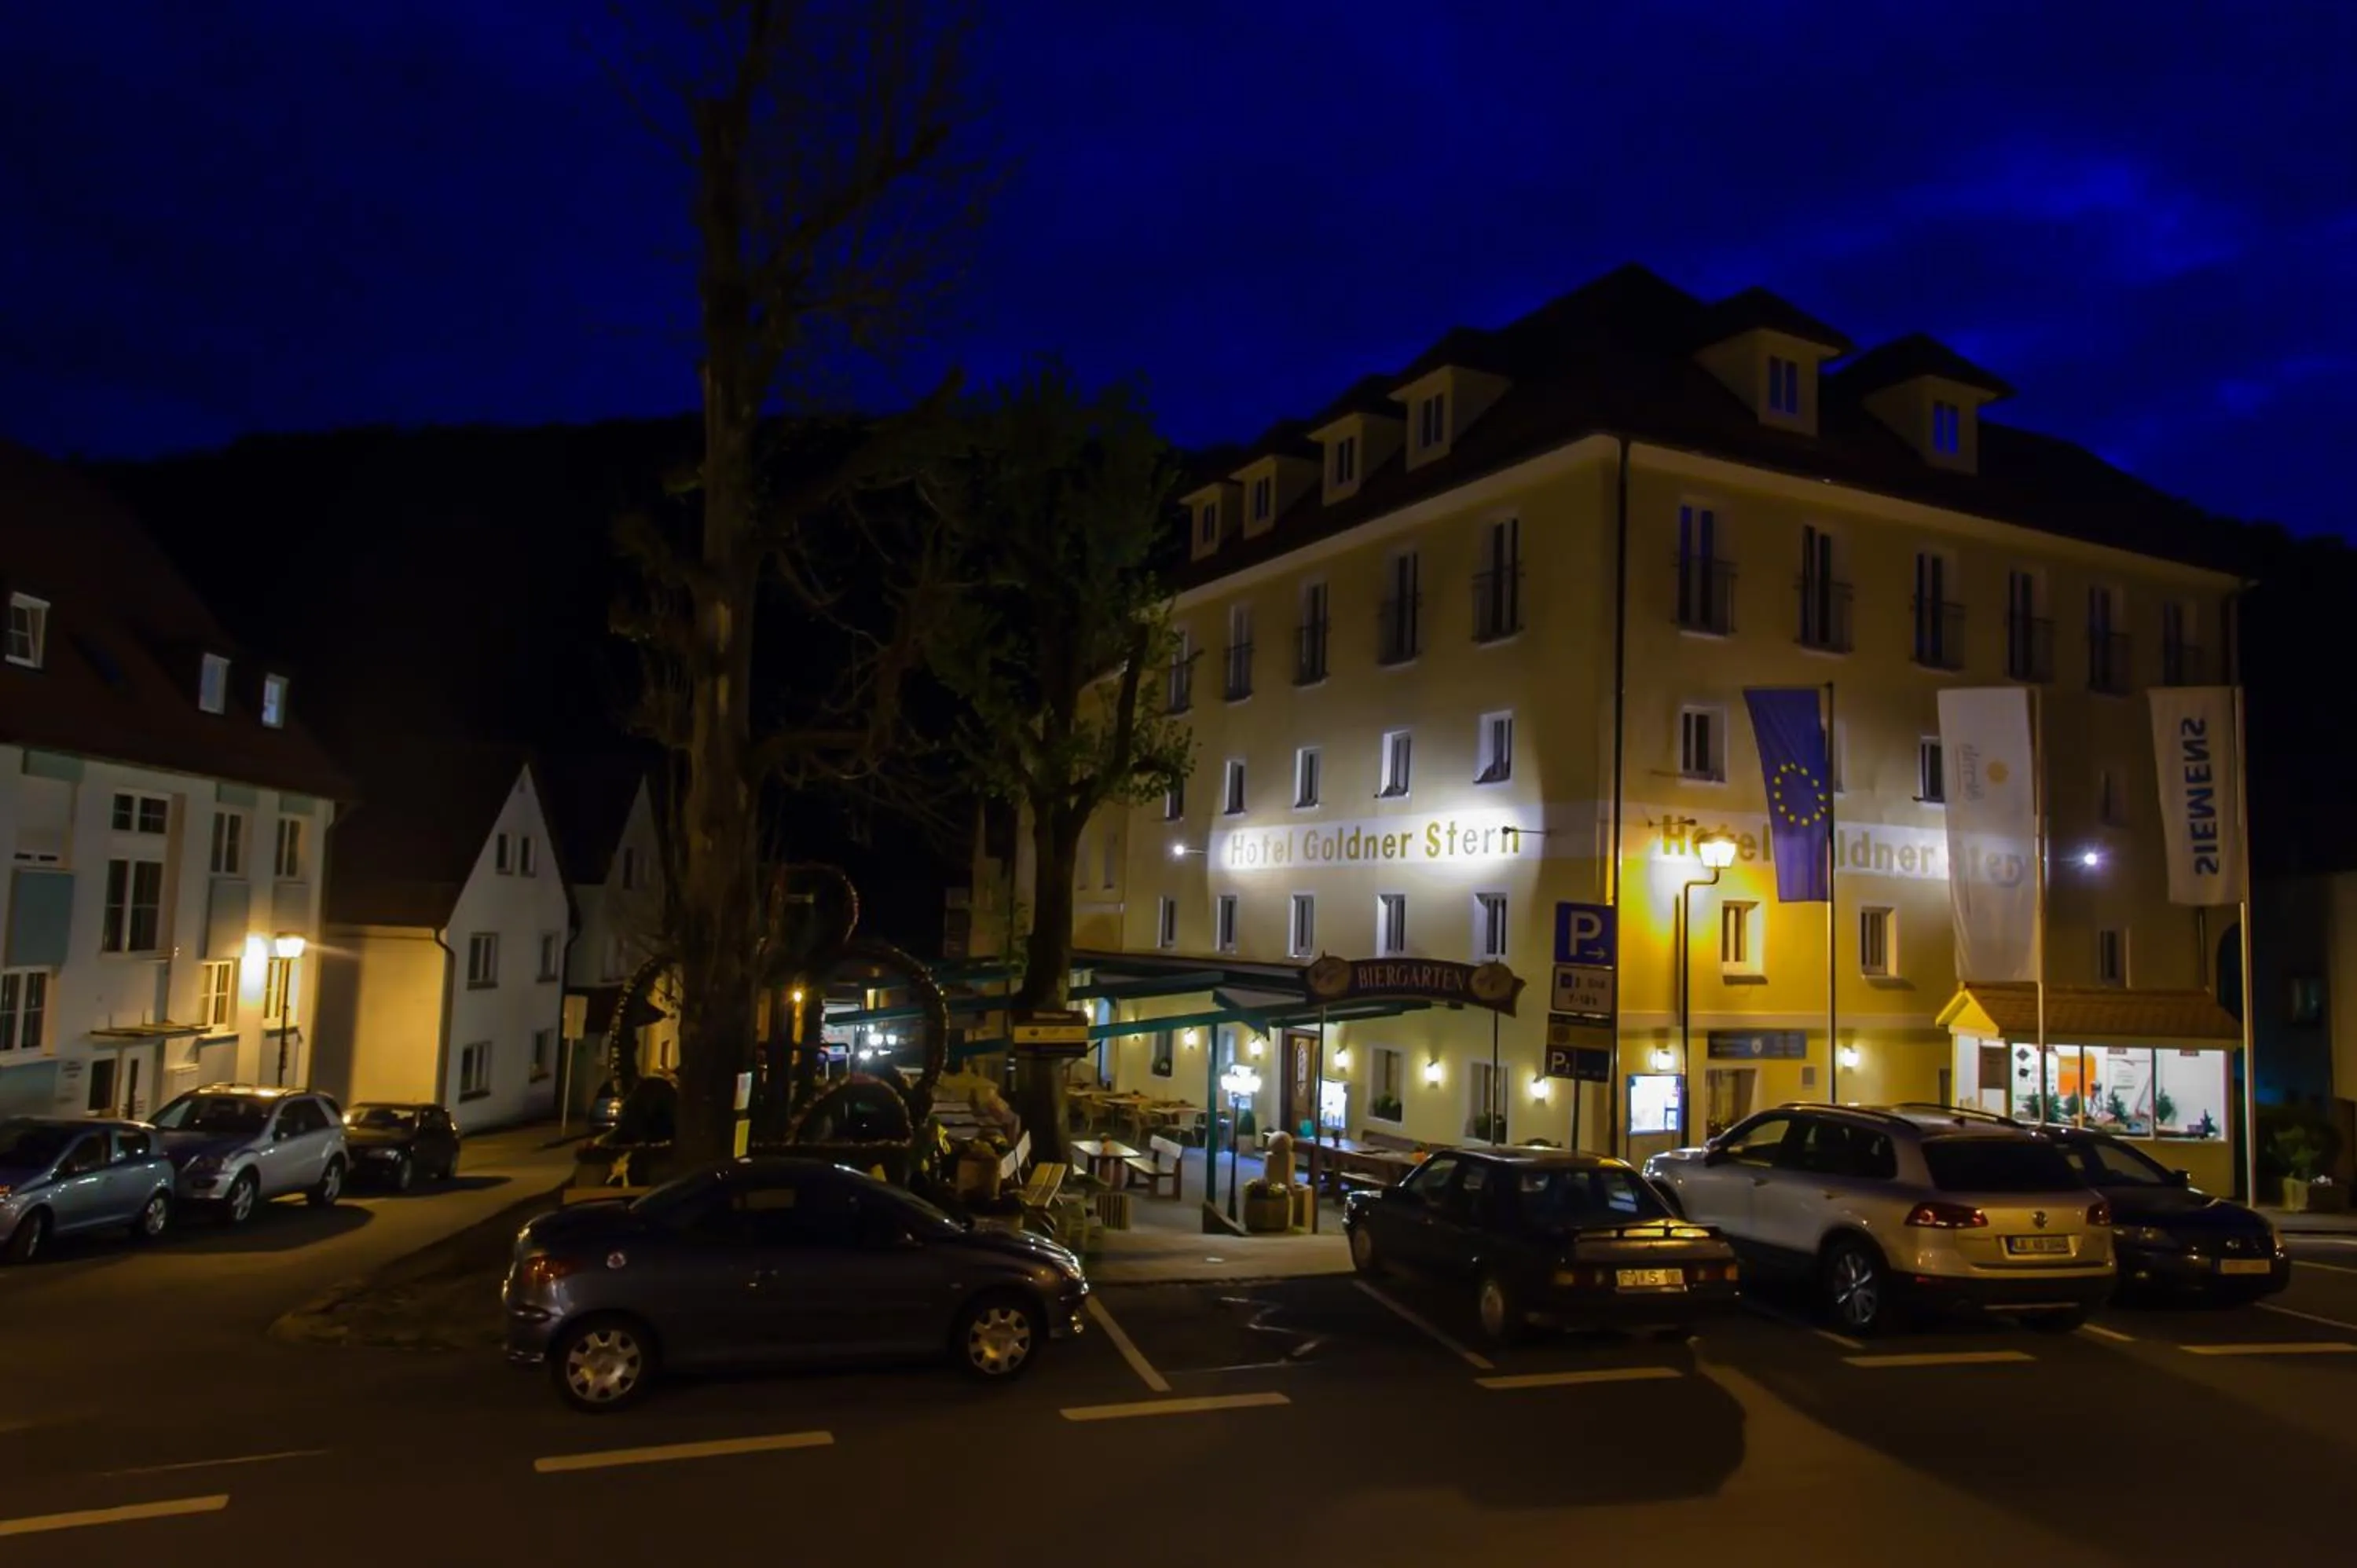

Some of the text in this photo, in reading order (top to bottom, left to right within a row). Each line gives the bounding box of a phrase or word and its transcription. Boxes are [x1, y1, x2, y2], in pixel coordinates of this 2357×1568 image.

[1230, 822, 1519, 865] Hotel Goldner Stern
[1838, 829, 1935, 874] ldner
[1569, 911, 1602, 957] P
[1357, 965, 1468, 991] BIERGARTEN
